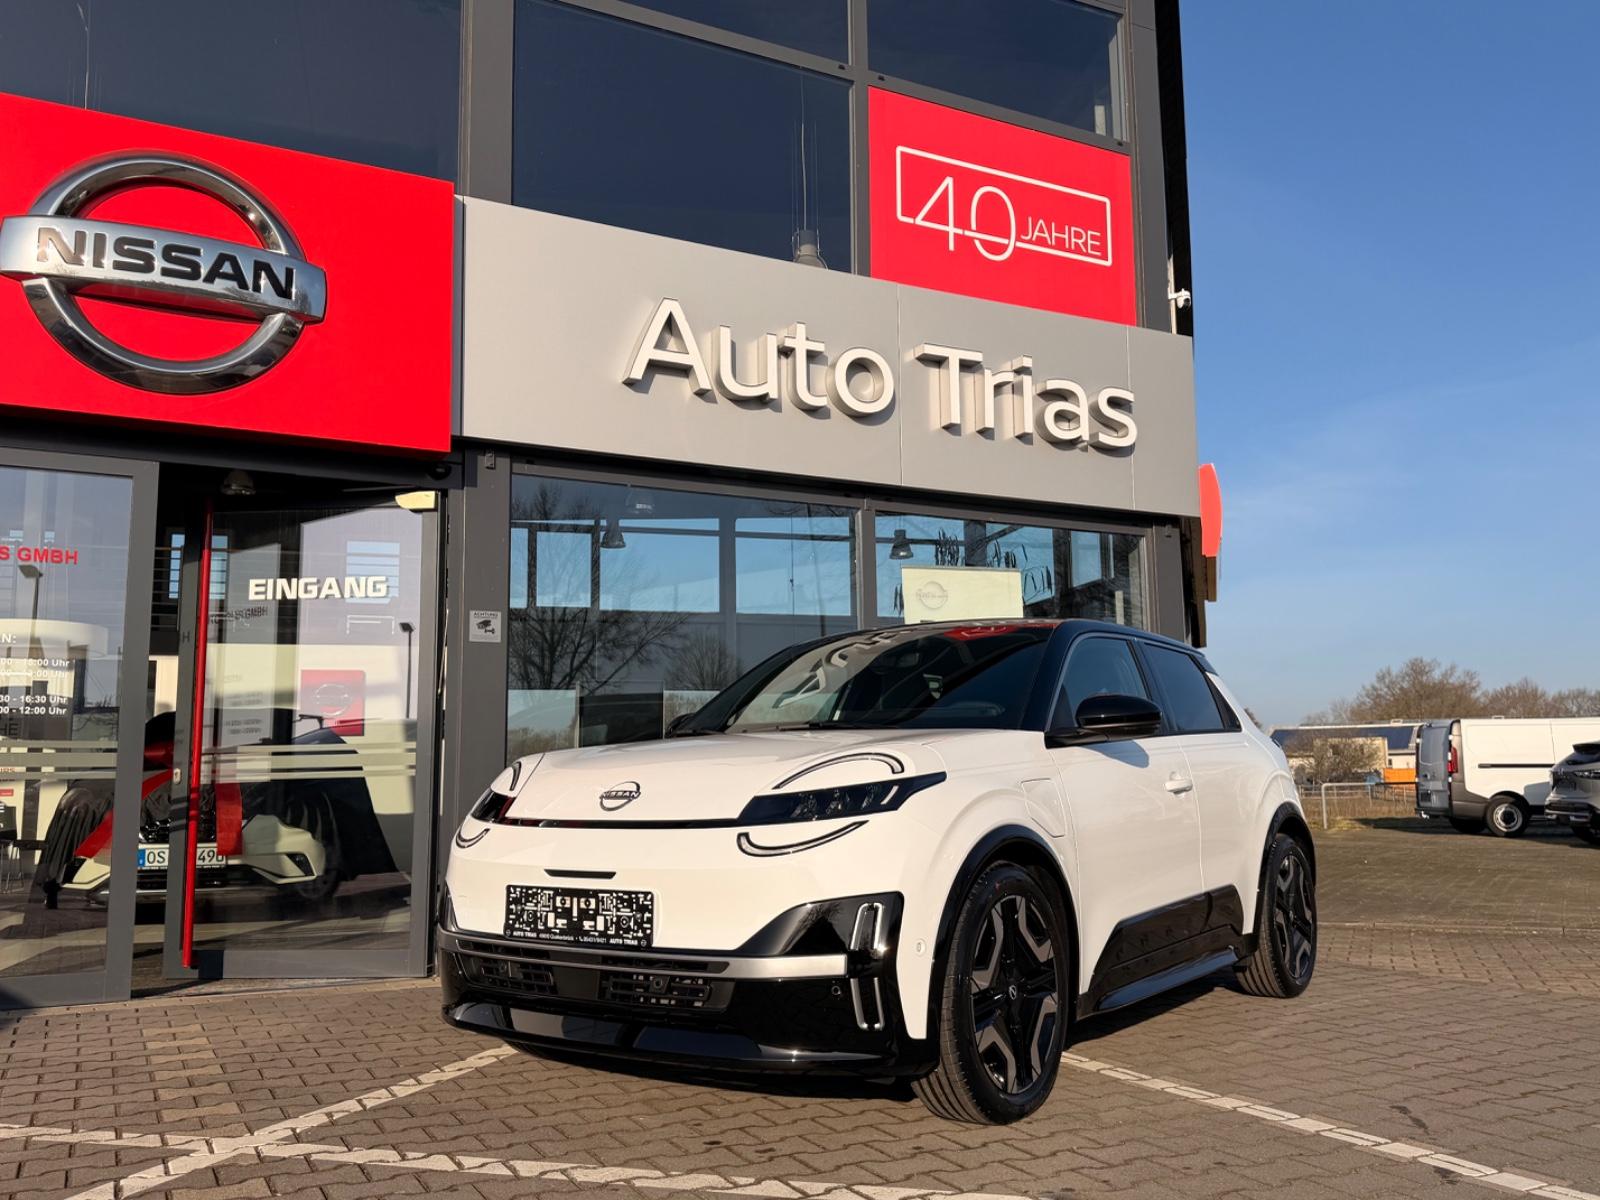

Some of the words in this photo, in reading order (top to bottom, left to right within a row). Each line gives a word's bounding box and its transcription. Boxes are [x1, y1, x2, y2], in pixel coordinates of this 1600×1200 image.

[914, 176, 1016, 262] 40
[1021, 216, 1102, 257] JAHRE
[36, 226, 297, 300] NISSAN
[622, 296, 895, 418] Auto
[915, 341, 1138, 450] Trias
[17, 546, 79, 565] GMBH
[249, 576, 388, 600] EINGANG
[51, 659, 70, 667] Uhr
[20, 695, 47, 703] 16:30
[49, 695, 68, 704] Uhr
[19, 706, 46, 715] 12:00
[49, 706, 68, 715] Uhr
[147, 851, 166, 864] OS
